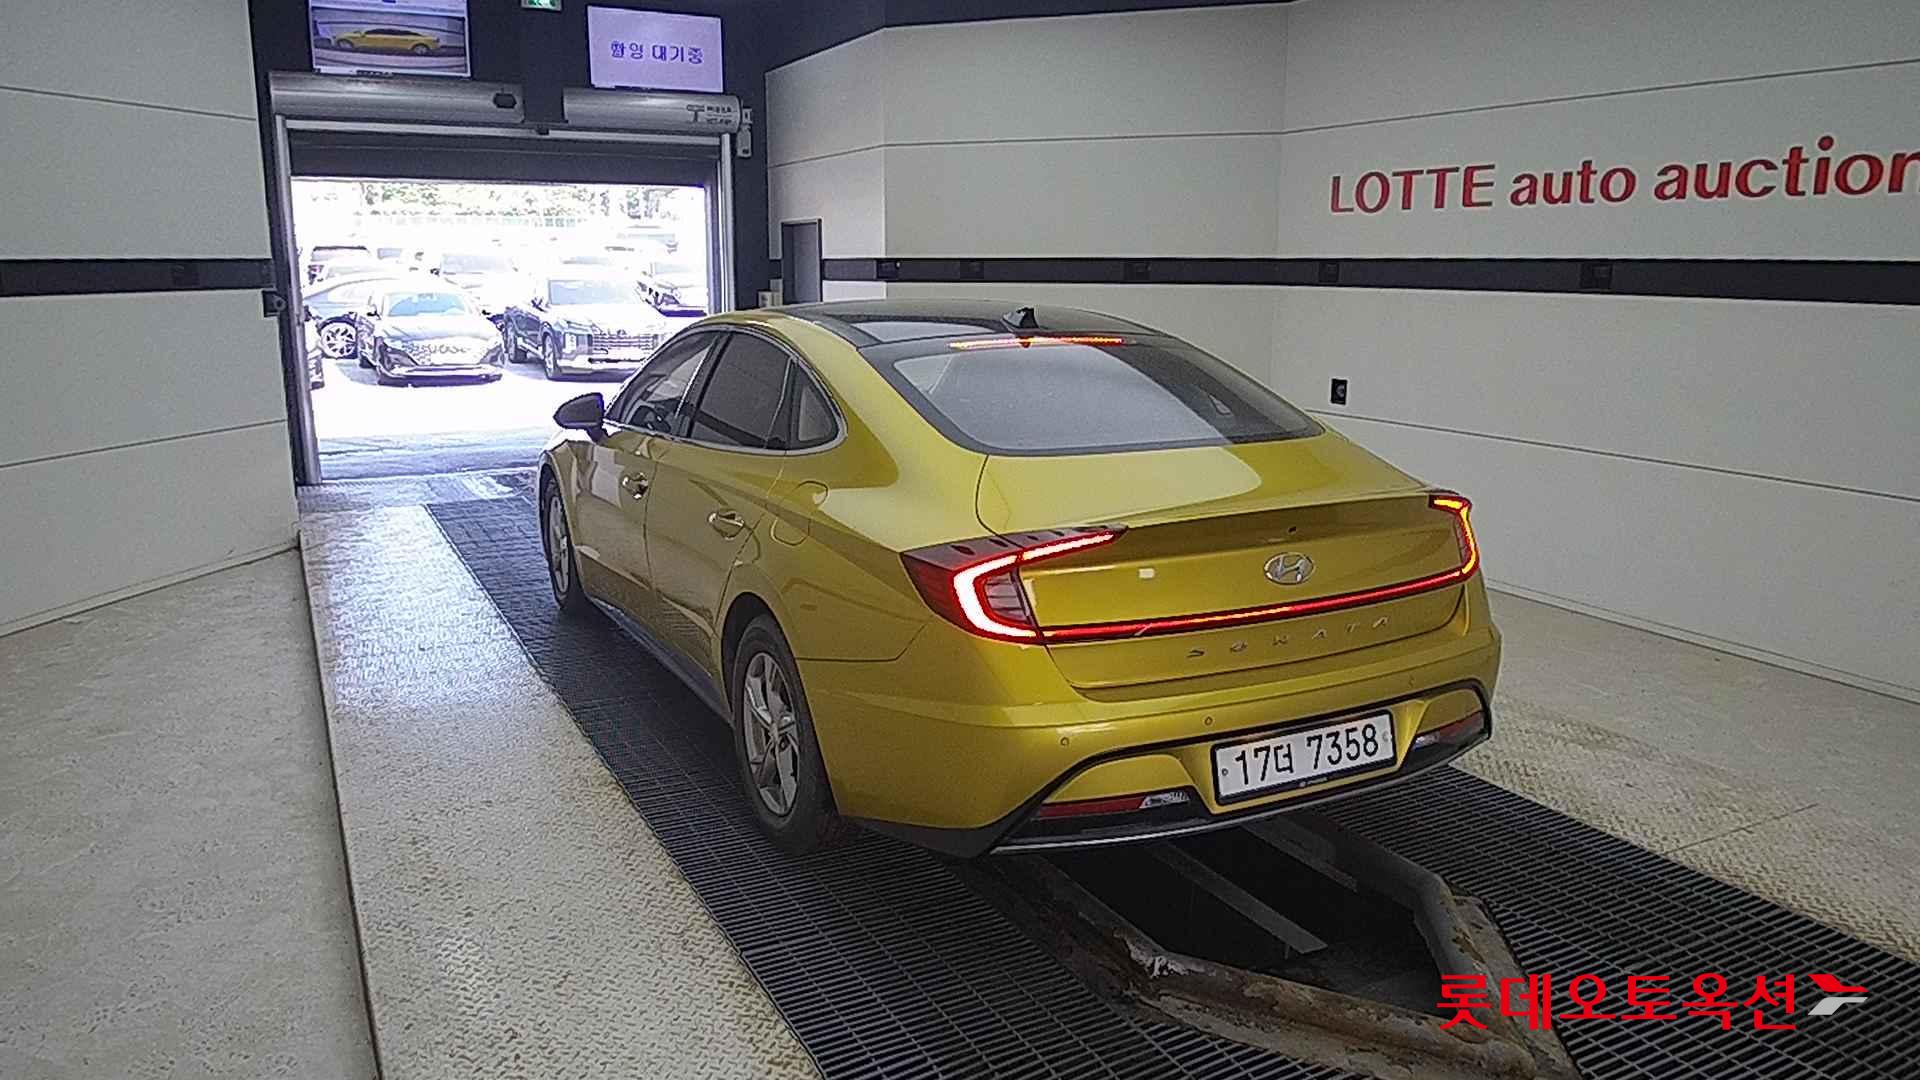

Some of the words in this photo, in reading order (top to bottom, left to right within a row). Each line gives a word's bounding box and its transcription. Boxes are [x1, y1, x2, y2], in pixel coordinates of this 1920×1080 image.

[652, 44, 703, 64] 대기중
[1331, 163, 1495, 213] LOTTE
[1510, 160, 1636, 206] auto
[1186, 616, 1390, 658] SONATA
[1235, 743, 1294, 785] 17더
[1306, 723, 1379, 770] 7358
